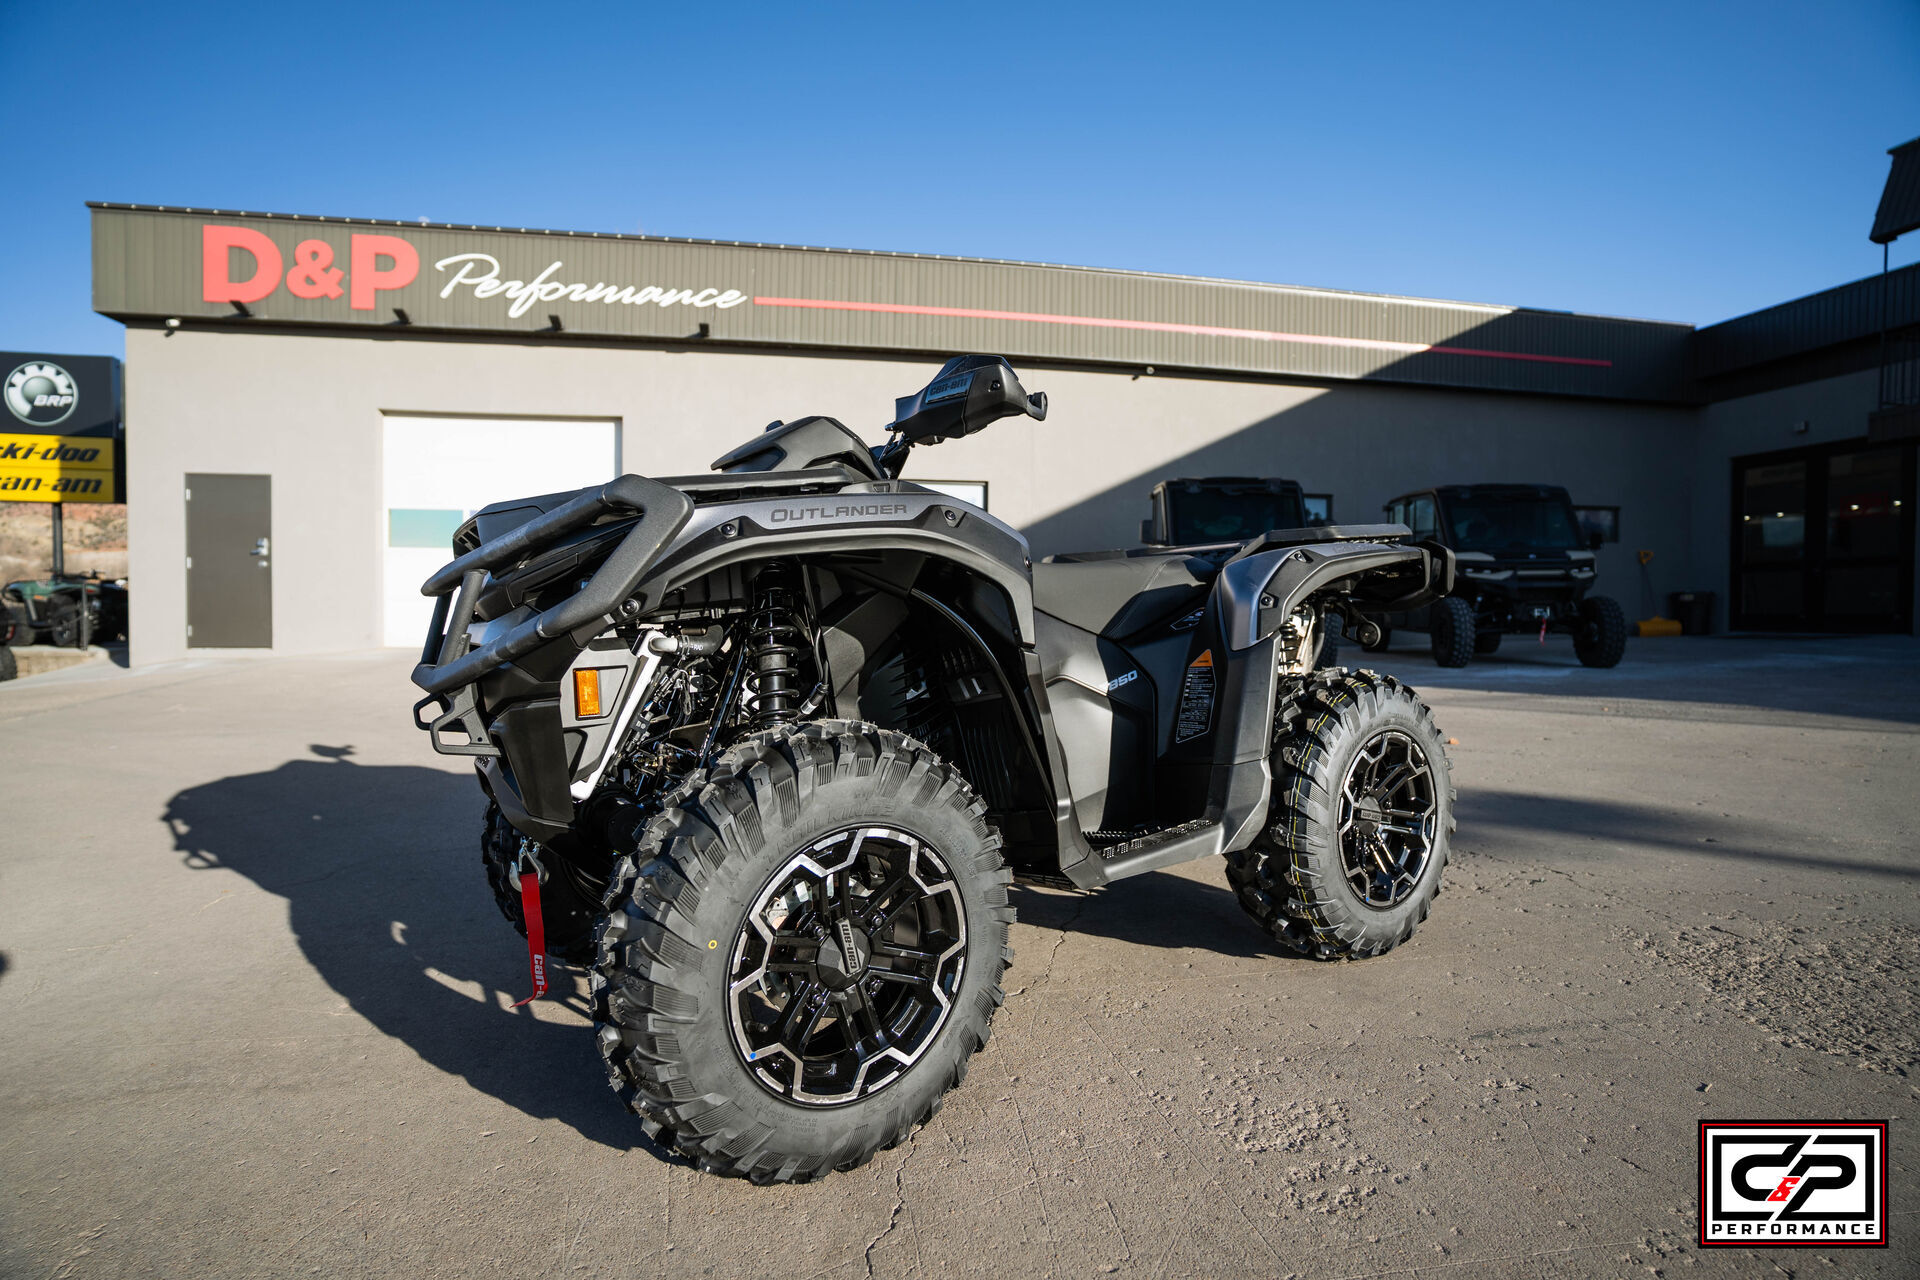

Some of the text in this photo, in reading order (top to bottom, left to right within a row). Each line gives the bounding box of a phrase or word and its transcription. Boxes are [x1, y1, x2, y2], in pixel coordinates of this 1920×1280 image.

[202, 224, 748, 318] D&P Performance
[33, 394, 74, 408] BRP
[0, 476, 103, 494] an-am
[770, 504, 908, 523] OUTLANDER
[841, 923, 860, 970] can-am
